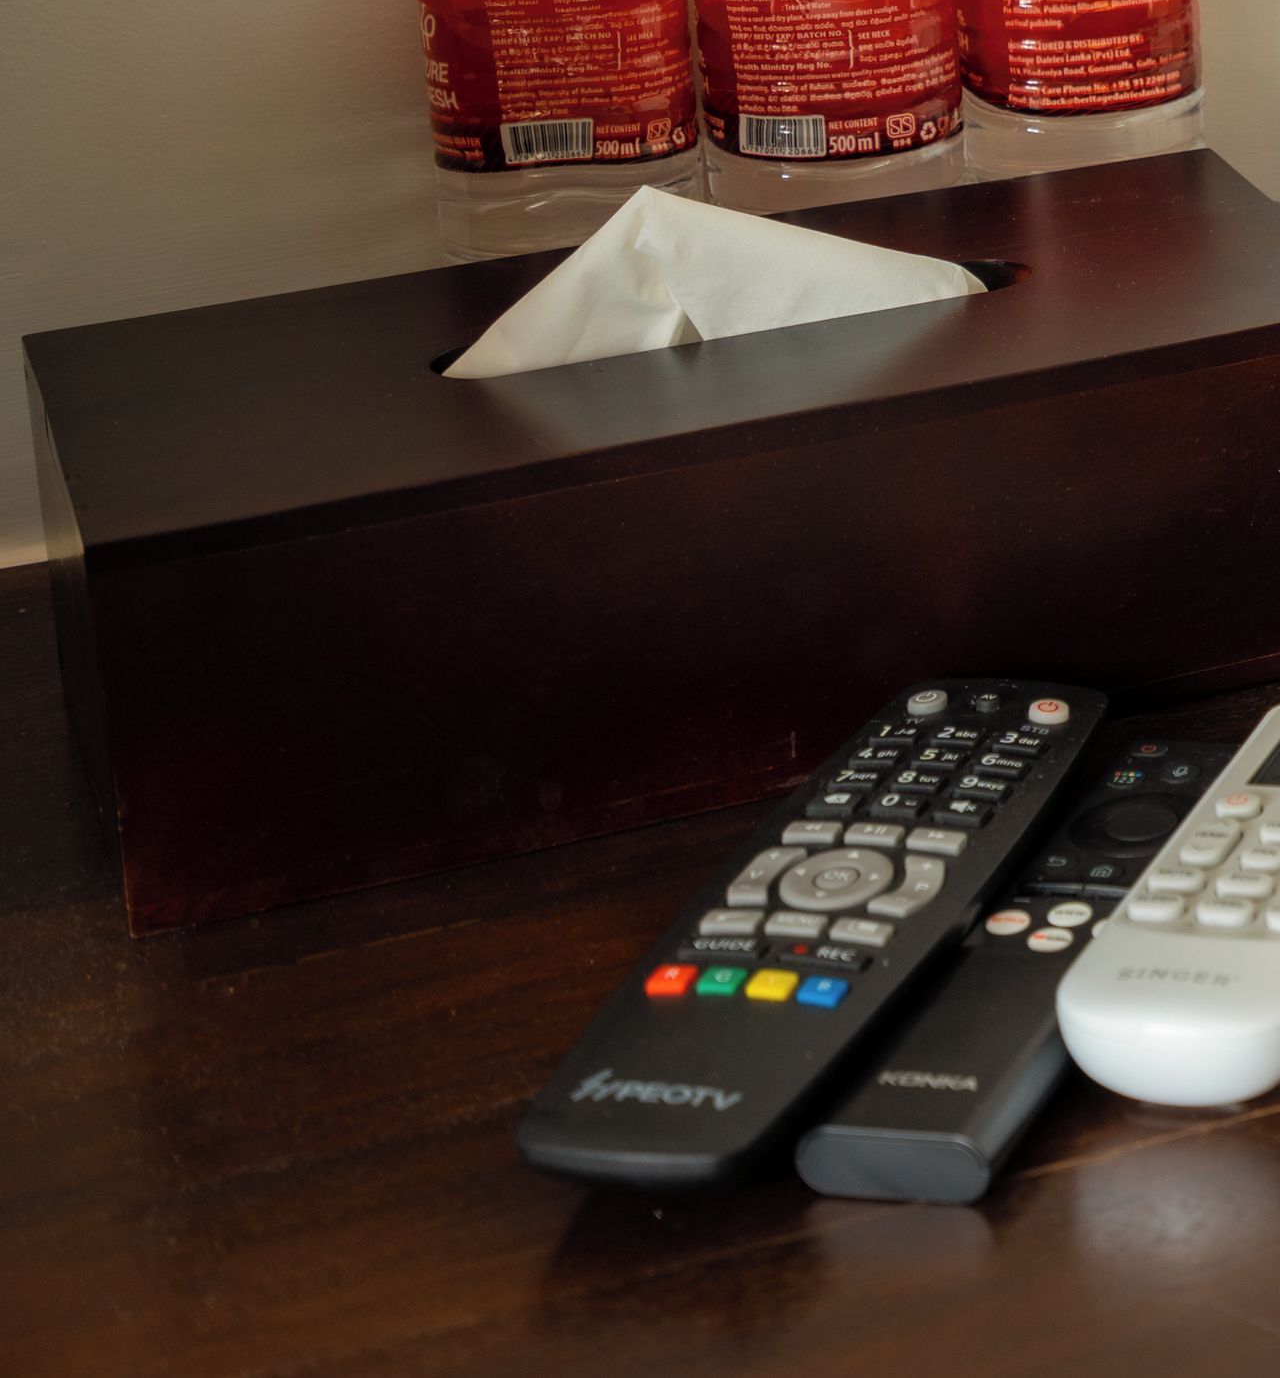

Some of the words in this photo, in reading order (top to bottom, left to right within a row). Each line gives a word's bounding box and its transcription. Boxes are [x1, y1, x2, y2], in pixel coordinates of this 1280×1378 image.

[797, 30, 827, 39] BATCH
[1074, 36, 1129, 50] DISTRIBUTED
[1036, 54, 1064, 64] Dairies
[1066, 53, 1092, 62] Lanka
[1093, 50, 1114, 61] (Pvt)
[761, 62, 794, 72] Ministry
[797, 62, 814, 71] Reg
[816, 61, 832, 69] No.
[1042, 86, 1061, 94] Care
[1063, 83, 1092, 94] Phone
[596, 125, 610, 134] NET
[611, 123, 640, 133] CONTENT
[829, 122, 843, 131] NET
[844, 118, 878, 129] CONTENT
[879, 725, 891, 737] 1
[937, 726, 954, 739] 2
[955, 730, 977, 739] abc
[1000, 732, 1018, 744] 3
[1018, 737, 1040, 746] def
[858, 748, 872, 758] 4
[877, 749, 898, 759] ghi
[919, 749, 937, 760] 5
[981, 754, 995, 766] 6
[835, 770, 853, 782] 7
[897, 771, 916, 784] 8
[919, 775, 939, 784] tuv
[1113, 775, 1136, 785] 123
[960, 776, 978, 790] 9
[978, 781, 1006, 791] wxyz
[824, 867, 851, 882] OK
[693, 939, 757, 952] GUIDE
[817, 946, 857, 962] REC
[1115, 966, 1231, 989] SINGER
[877, 1070, 979, 1092] KONKA
